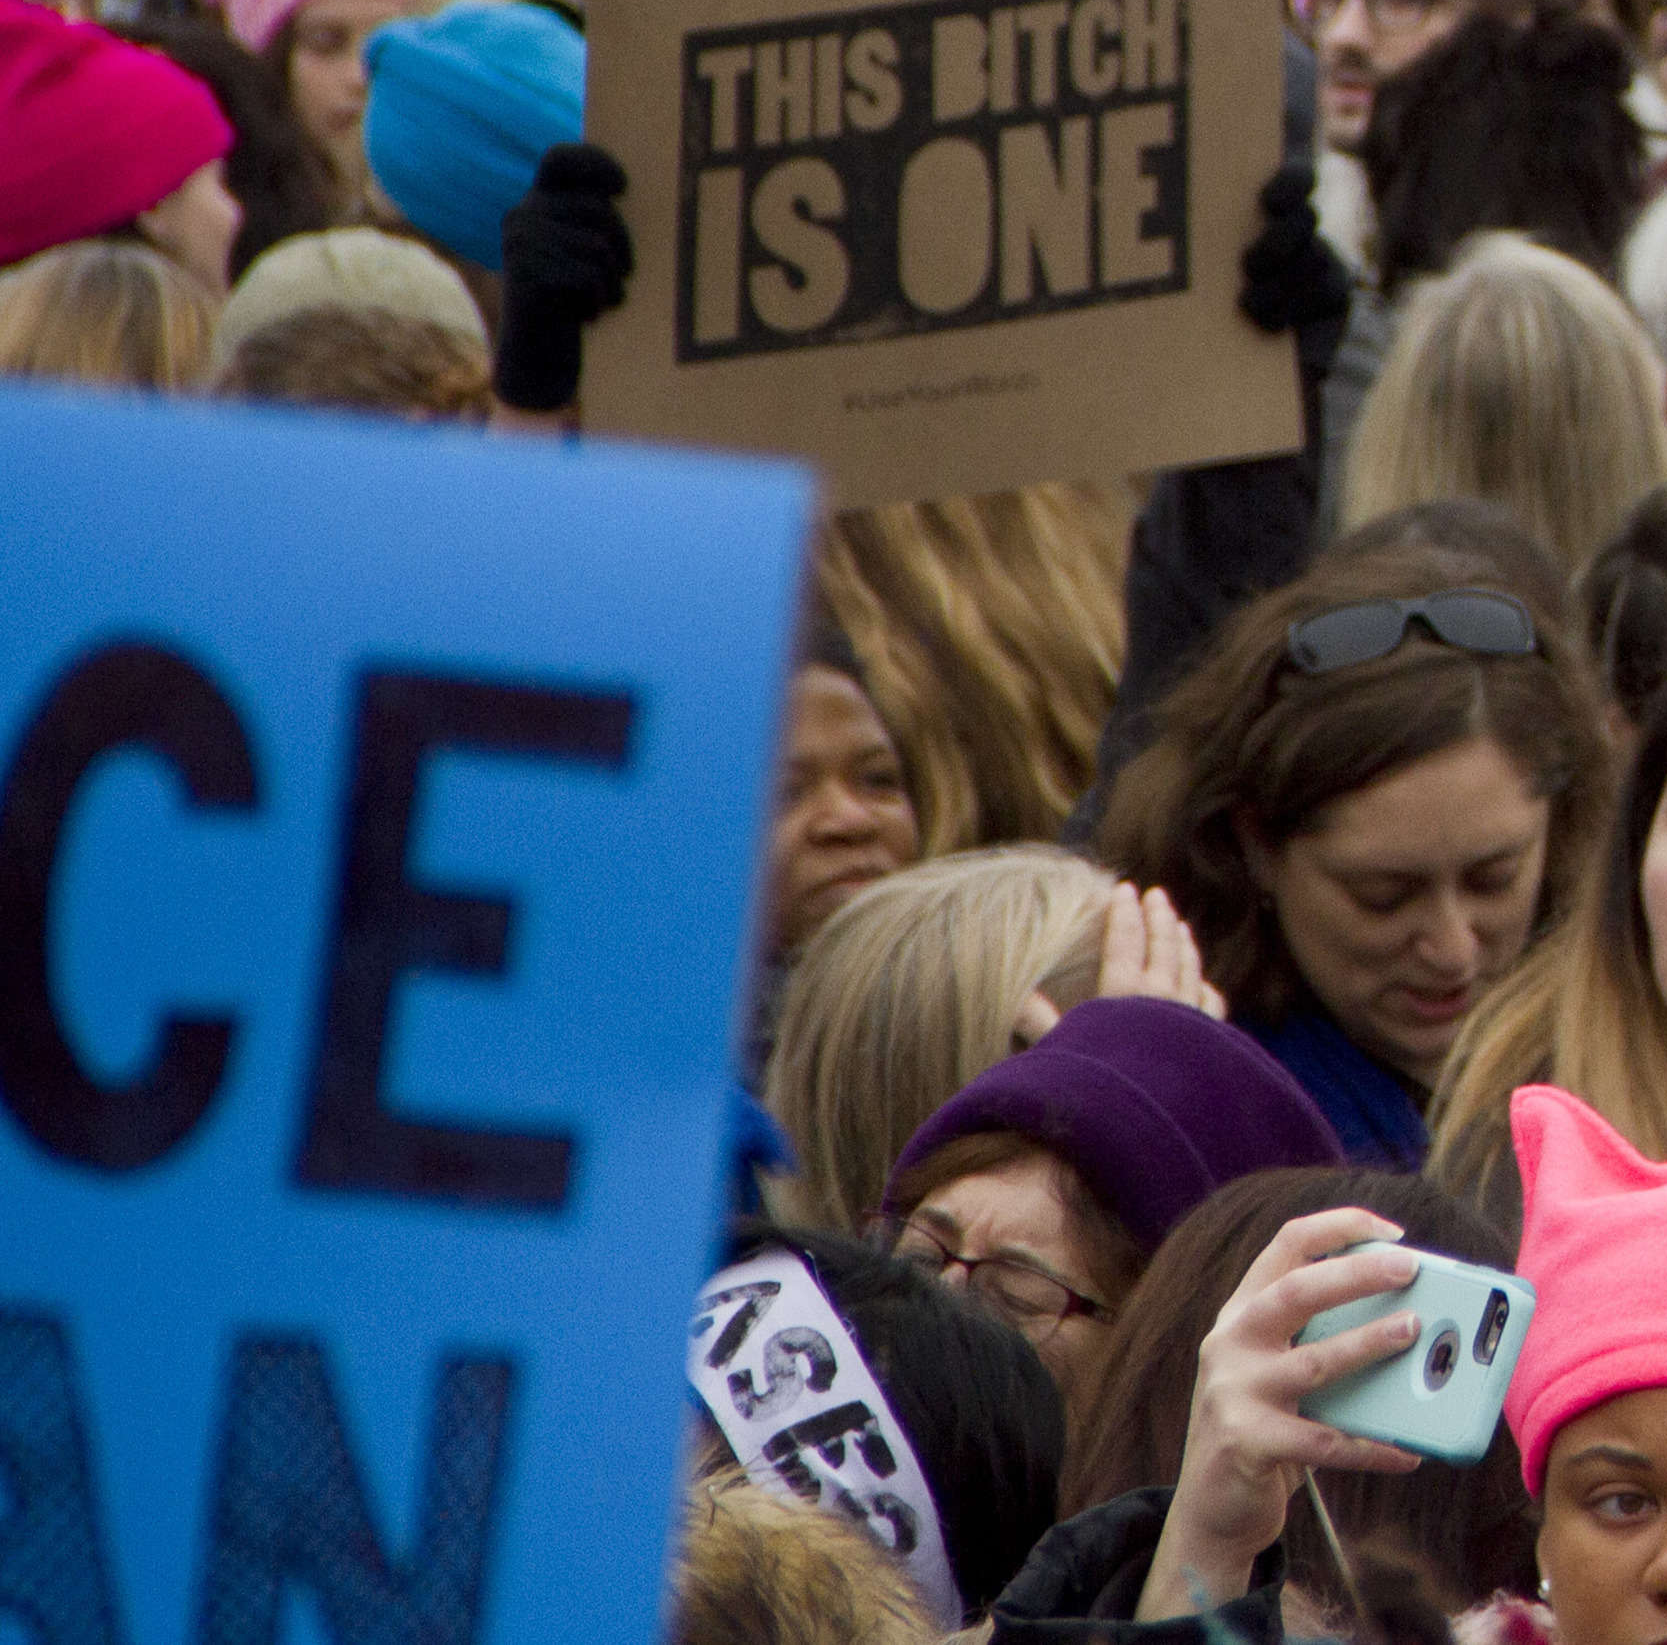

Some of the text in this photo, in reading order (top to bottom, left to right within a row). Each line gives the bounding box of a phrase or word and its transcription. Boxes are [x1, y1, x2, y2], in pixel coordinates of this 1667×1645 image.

[695, 29, 906, 156] THIS
[691, 100, 1180, 345] IS ONE
